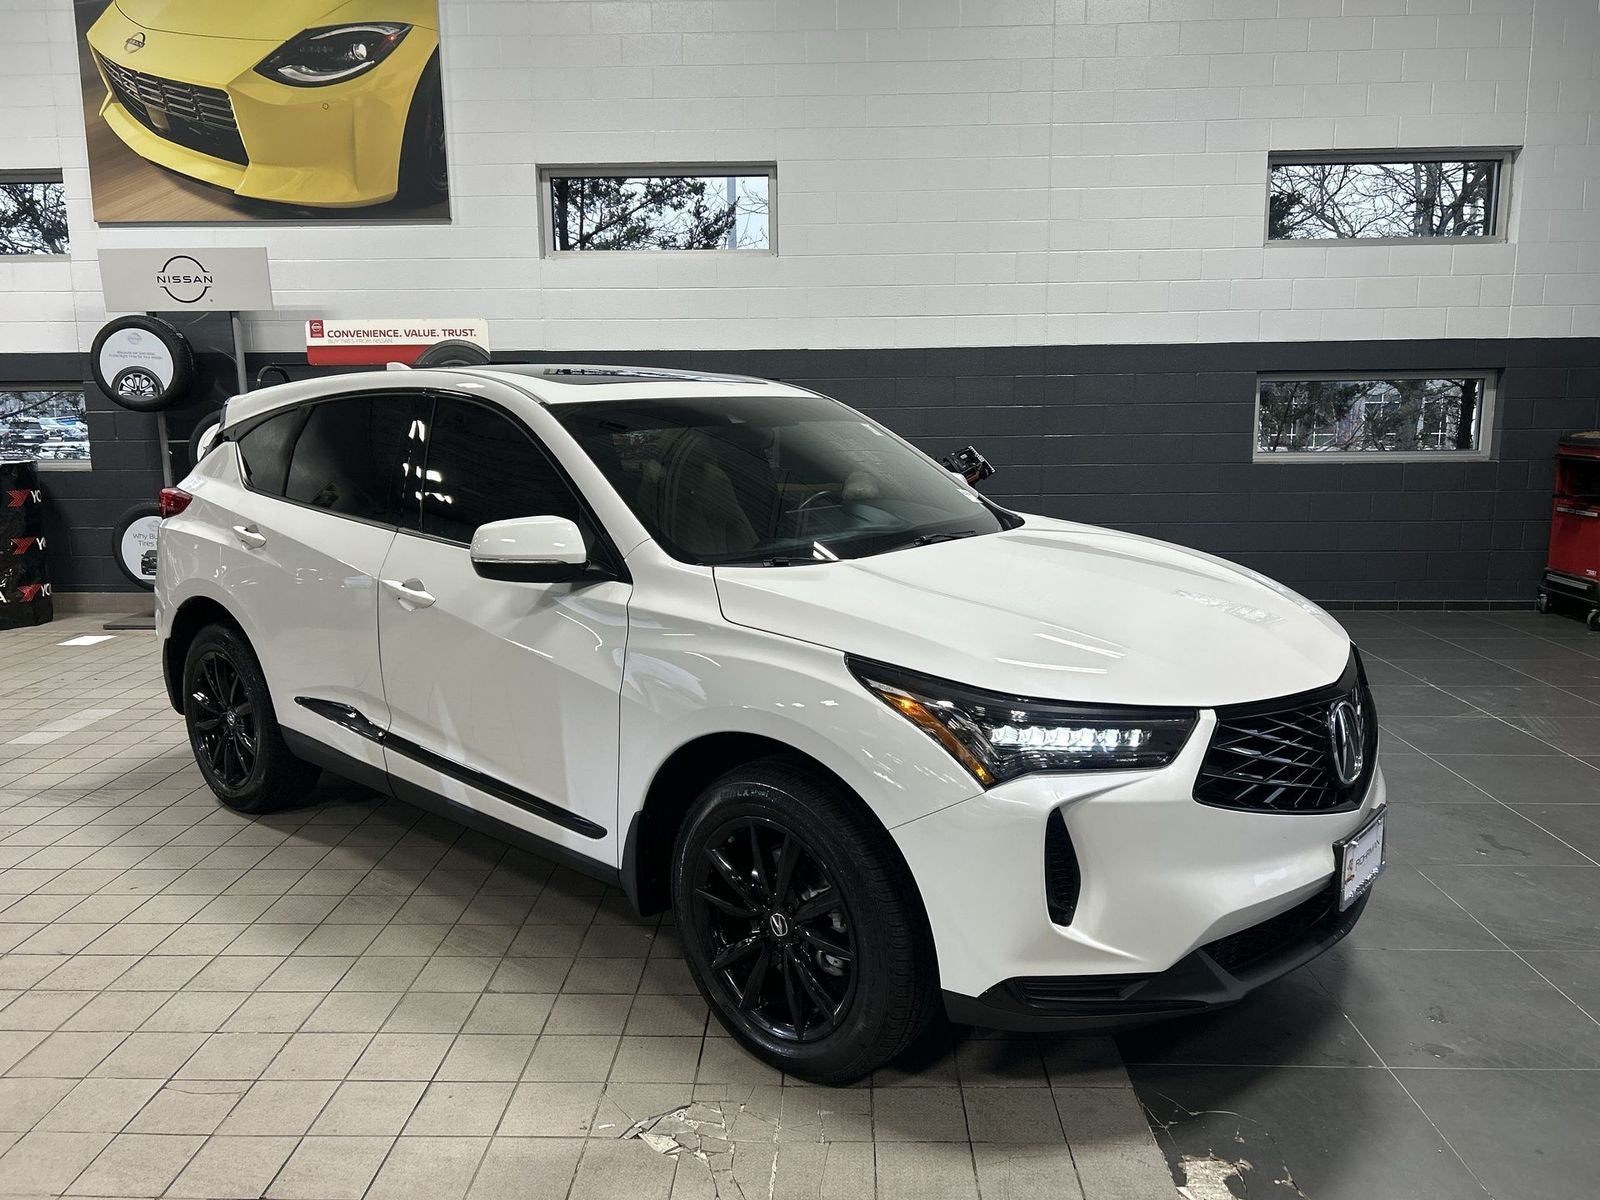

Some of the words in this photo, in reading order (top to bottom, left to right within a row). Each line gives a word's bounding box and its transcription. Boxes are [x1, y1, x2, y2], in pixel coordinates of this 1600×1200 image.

[157, 275, 213, 283] NISSAN
[327, 329, 402, 339] CONVENIENCE.
[404, 328, 439, 338] VALUE.
[441, 328, 477, 337] TRUST.
[132, 532, 148, 540] Why
